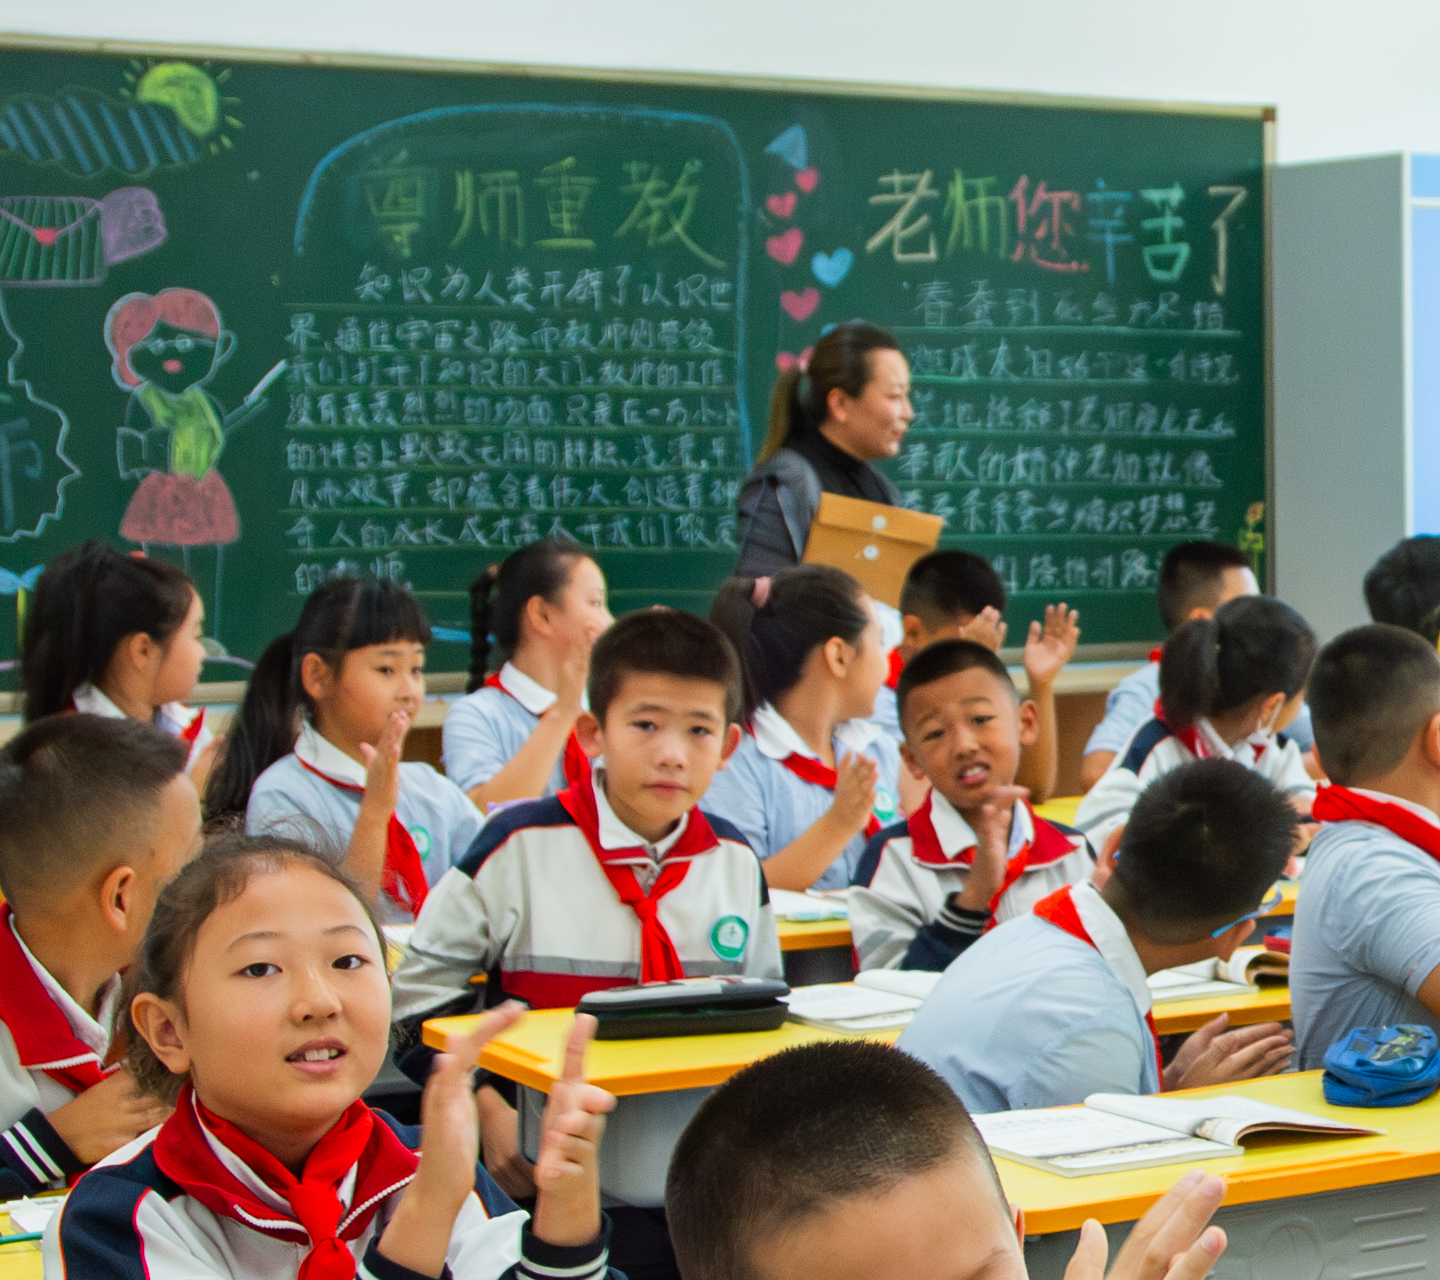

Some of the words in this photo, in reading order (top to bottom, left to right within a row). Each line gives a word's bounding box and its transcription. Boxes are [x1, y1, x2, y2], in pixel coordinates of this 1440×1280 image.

[365, 149, 727, 268] 尊师重教
[865, 168, 1248, 296] 老师您辛苦了
